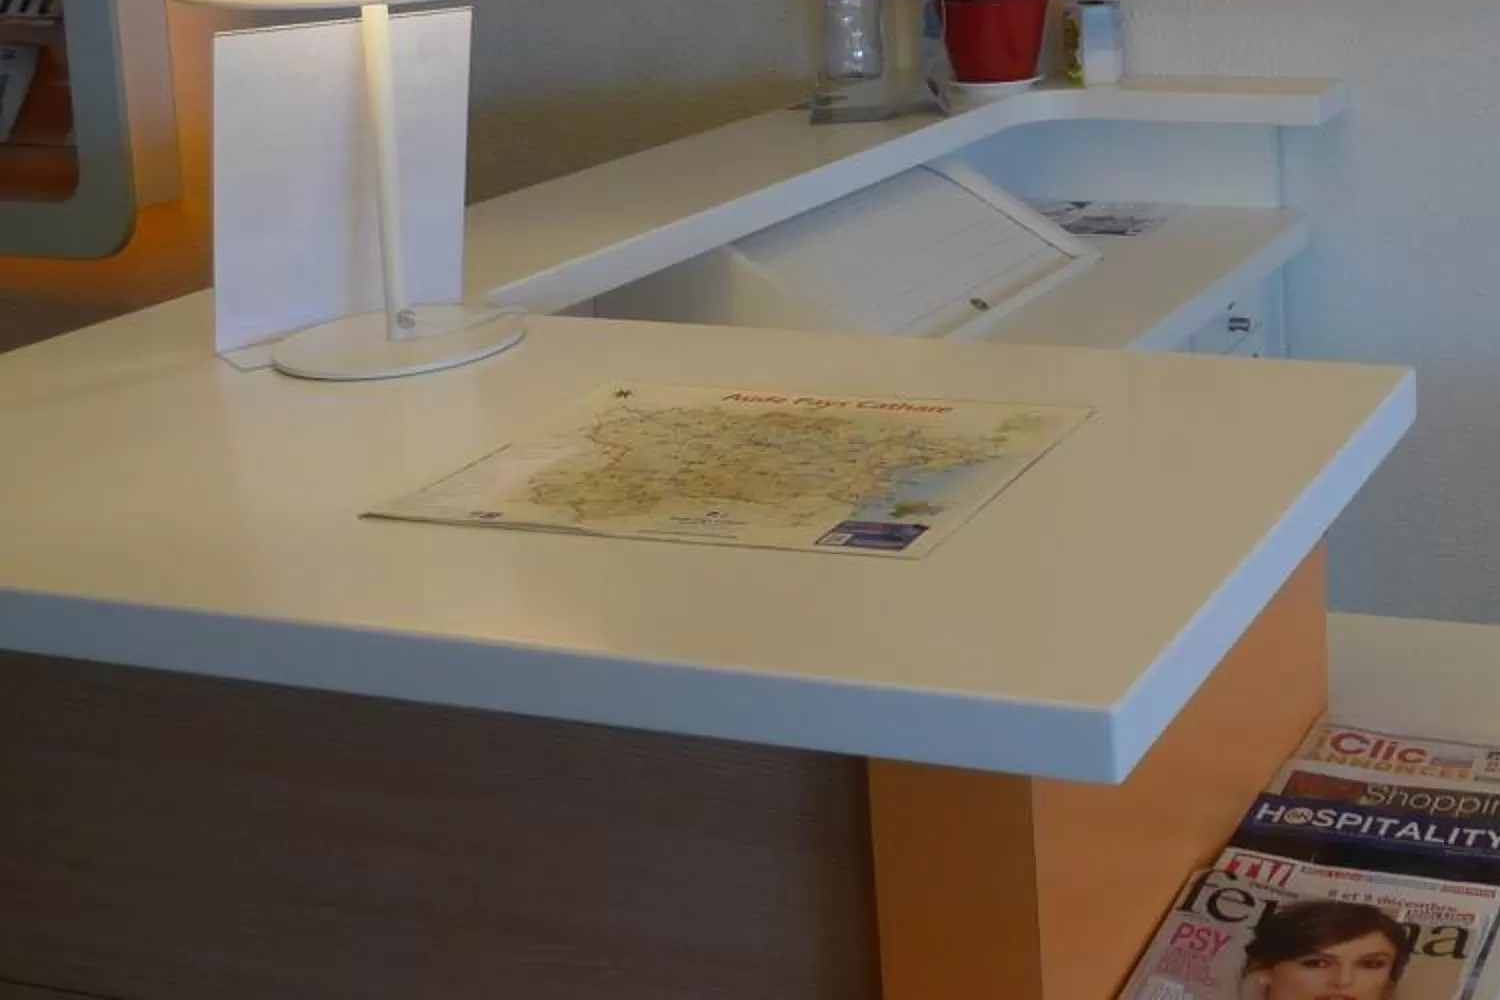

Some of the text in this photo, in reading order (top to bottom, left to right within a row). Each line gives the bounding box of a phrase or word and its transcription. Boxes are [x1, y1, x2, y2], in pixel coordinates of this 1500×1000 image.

[722, 392, 789, 404] Aude
[1329, 730, 1433, 766] Clic
[1176, 869, 1471, 960] féa
[1170, 921, 1233, 957] PSY
